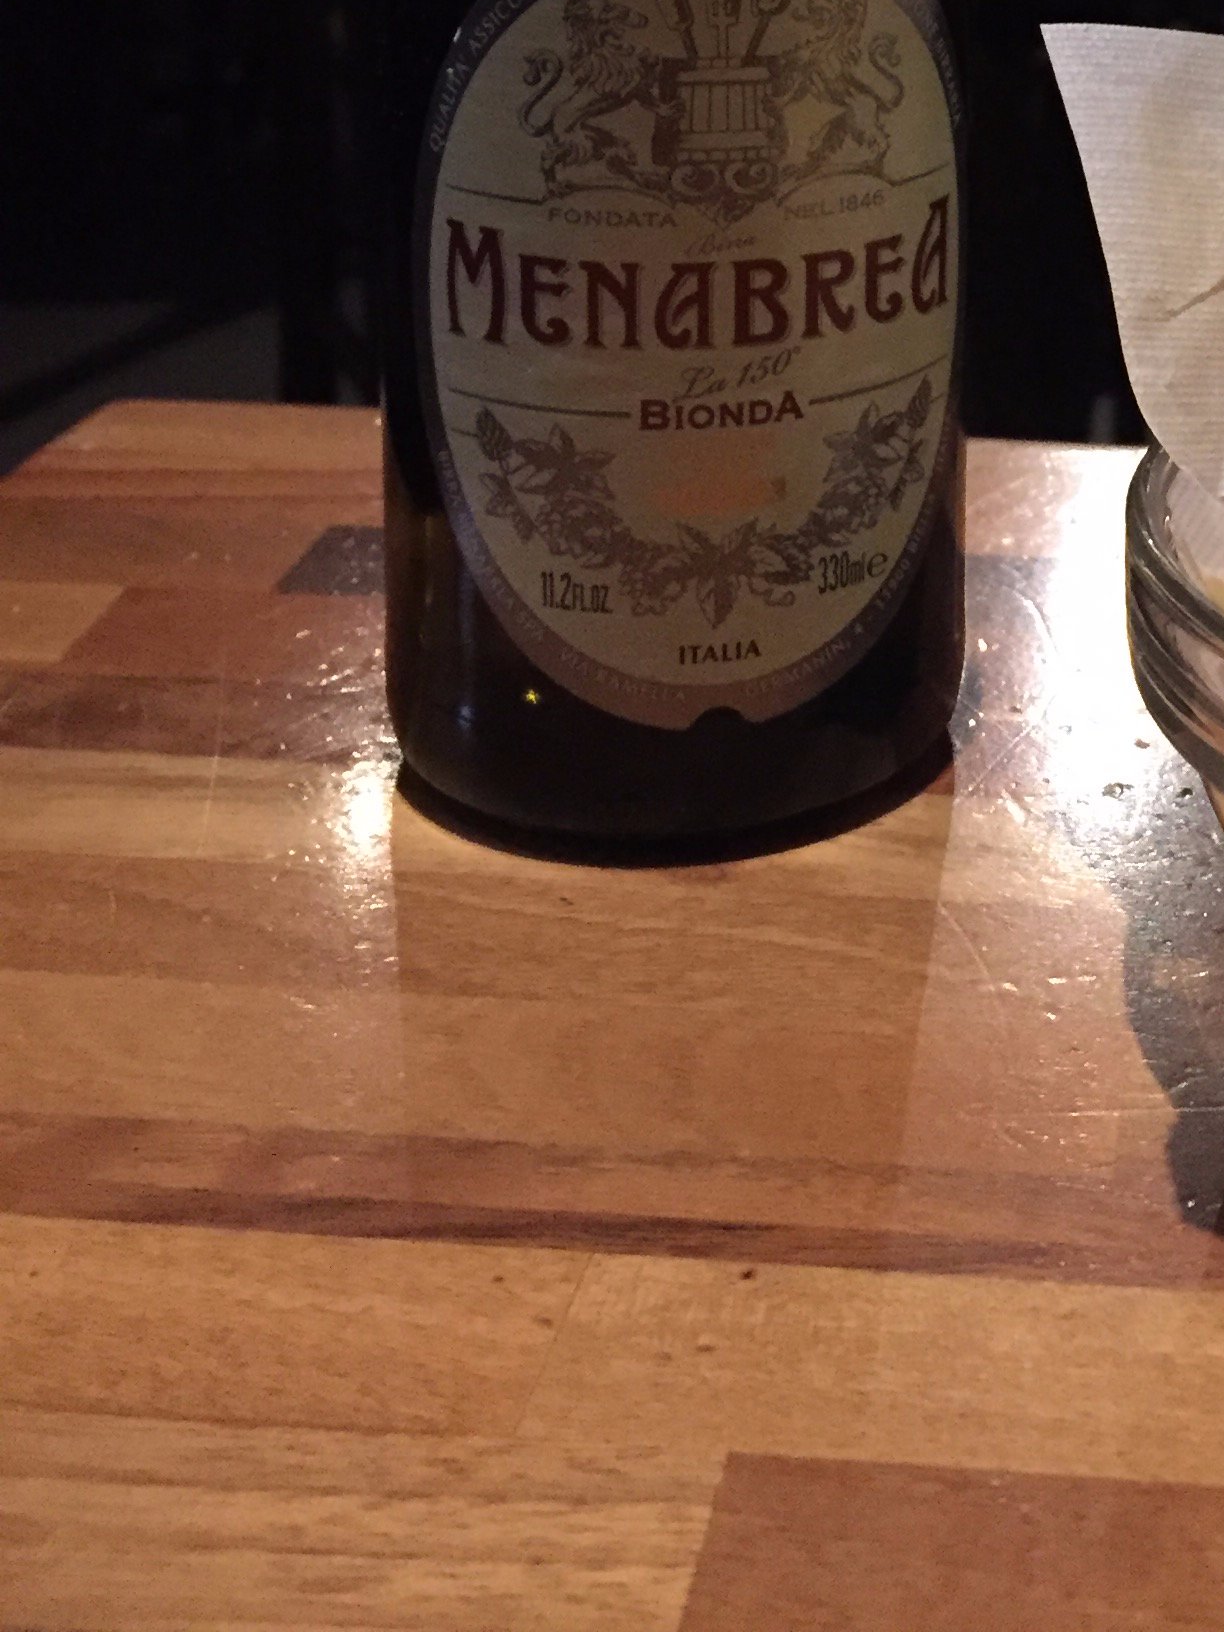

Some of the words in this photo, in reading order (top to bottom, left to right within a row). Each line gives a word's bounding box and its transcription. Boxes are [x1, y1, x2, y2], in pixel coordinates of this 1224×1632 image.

[548, 206, 679, 229] FONDATA
[784, 201, 834, 219] NEL
[839, 188, 884, 212] 1846
[446, 193, 950, 350] MENABREA
[672, 366, 727, 405] La
[639, 390, 804, 431] BIONDA
[678, 639, 761, 665] ITALIA
